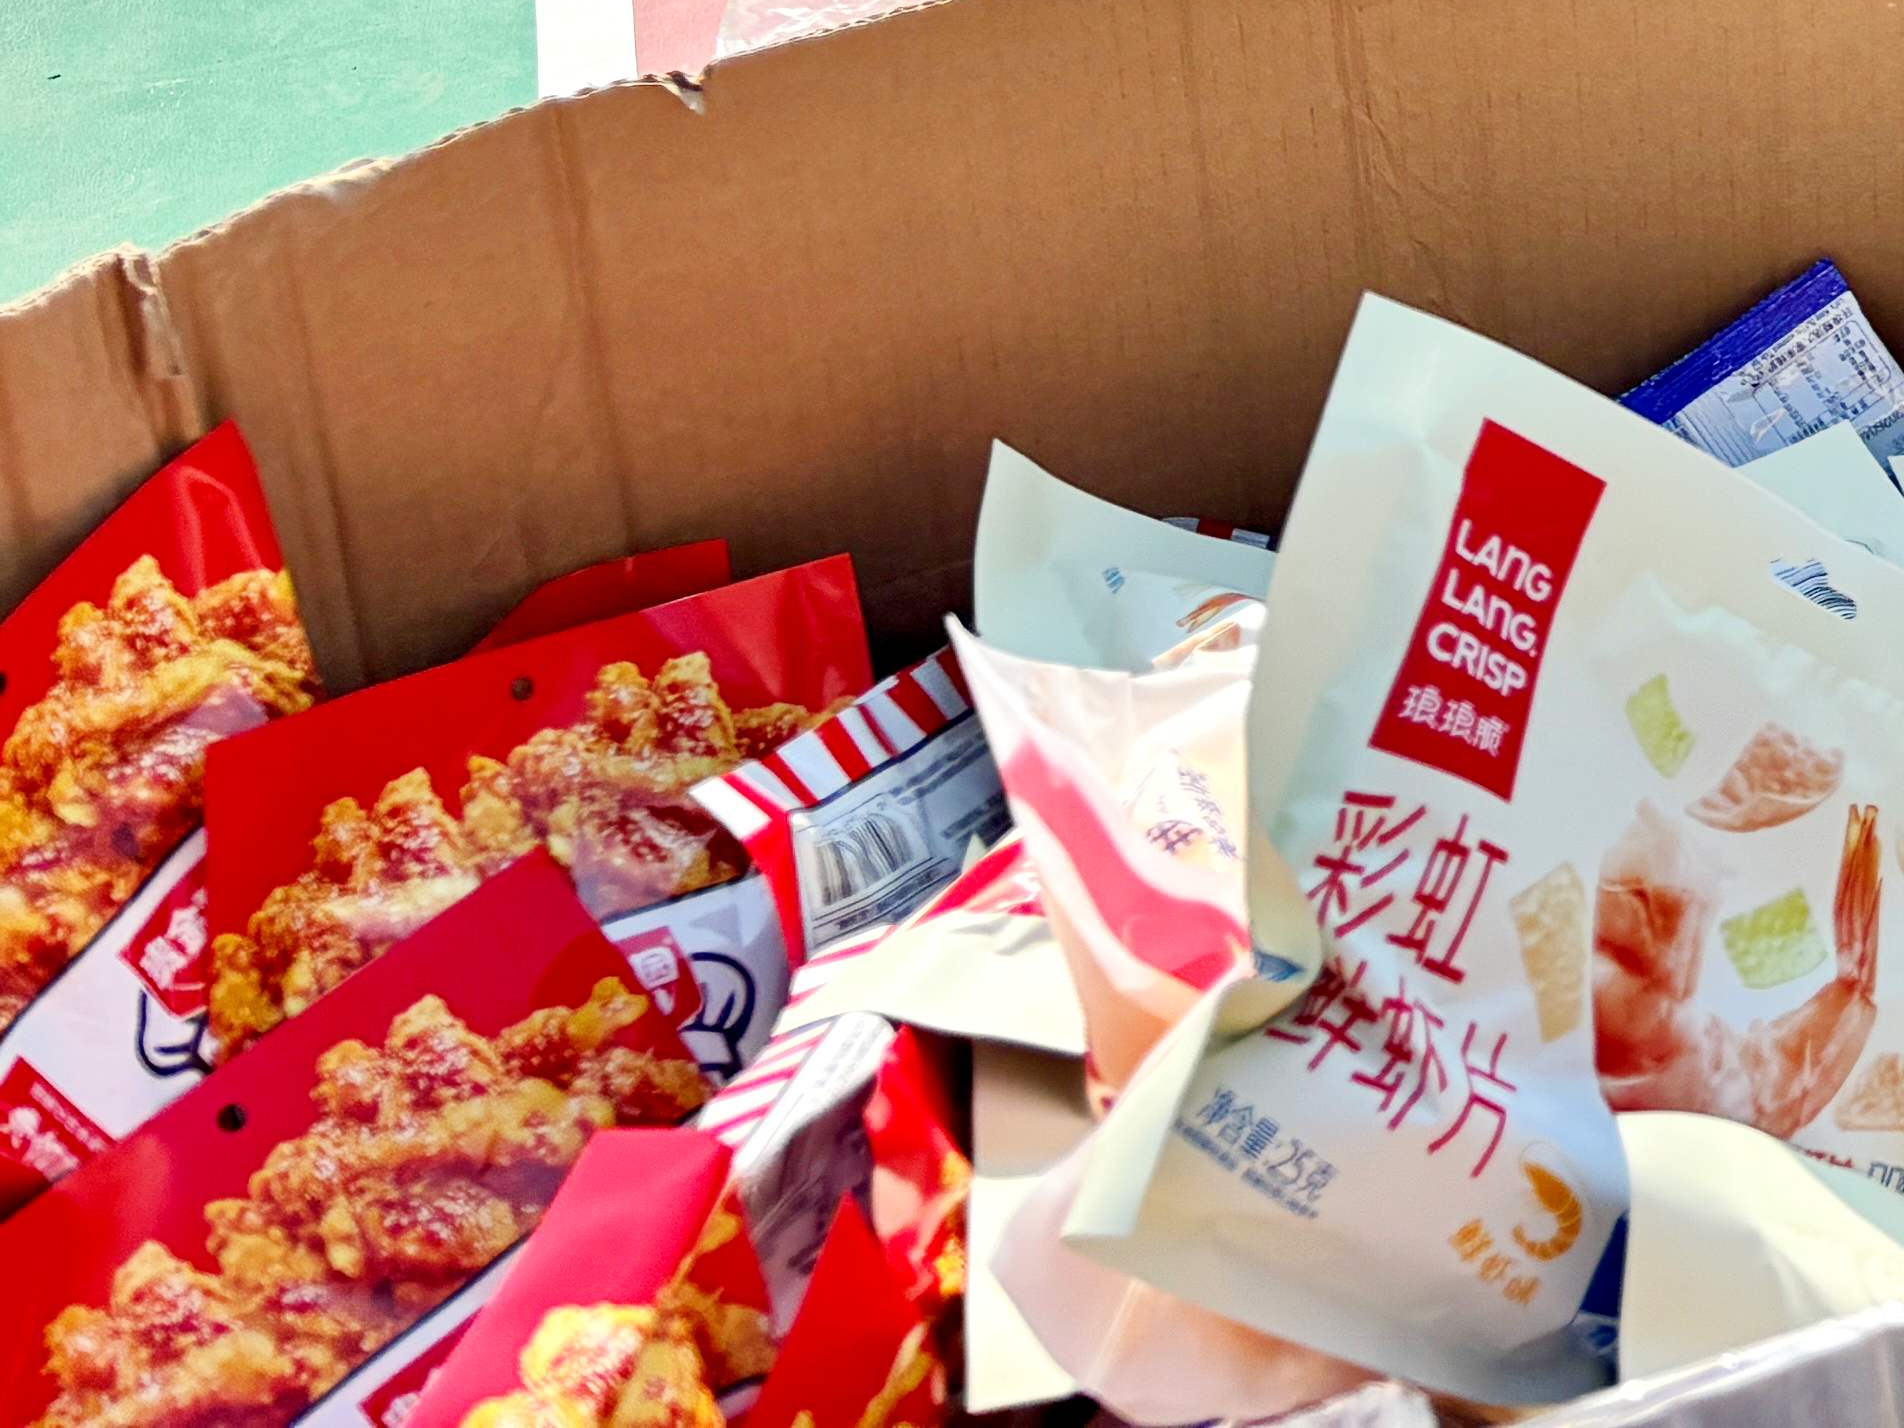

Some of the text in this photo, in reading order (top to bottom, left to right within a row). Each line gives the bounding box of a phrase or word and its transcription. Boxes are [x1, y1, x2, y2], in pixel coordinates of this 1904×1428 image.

[1452, 516, 1554, 603] LANG
[1426, 625, 1530, 698] CRISP
[1307, 789, 1511, 985] 彩虹
